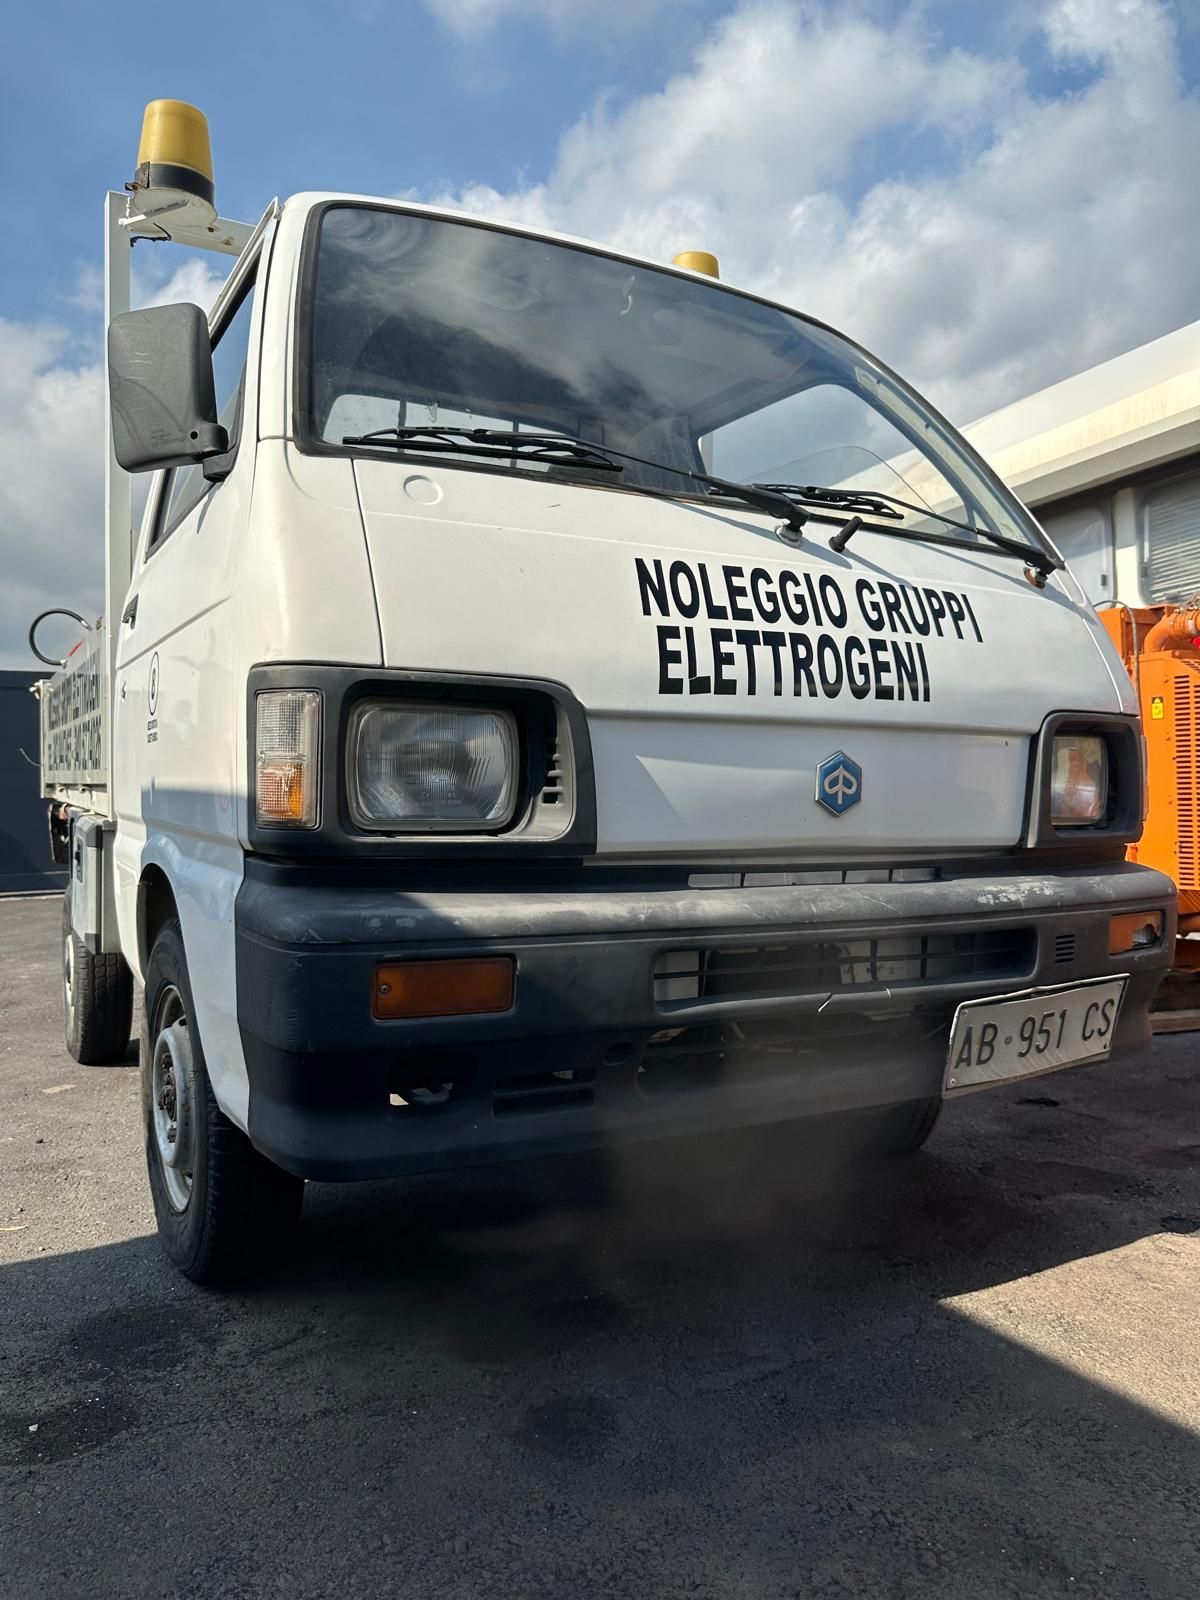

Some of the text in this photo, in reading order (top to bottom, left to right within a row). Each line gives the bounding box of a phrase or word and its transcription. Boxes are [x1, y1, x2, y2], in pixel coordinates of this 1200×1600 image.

[635, 558, 983, 642] NOLEGGIO GRUPPI
[656, 625, 931, 702] ELETTROGENI
[1018, 1008, 1067, 1058] 951
[1081, 998, 1115, 1042] CS
